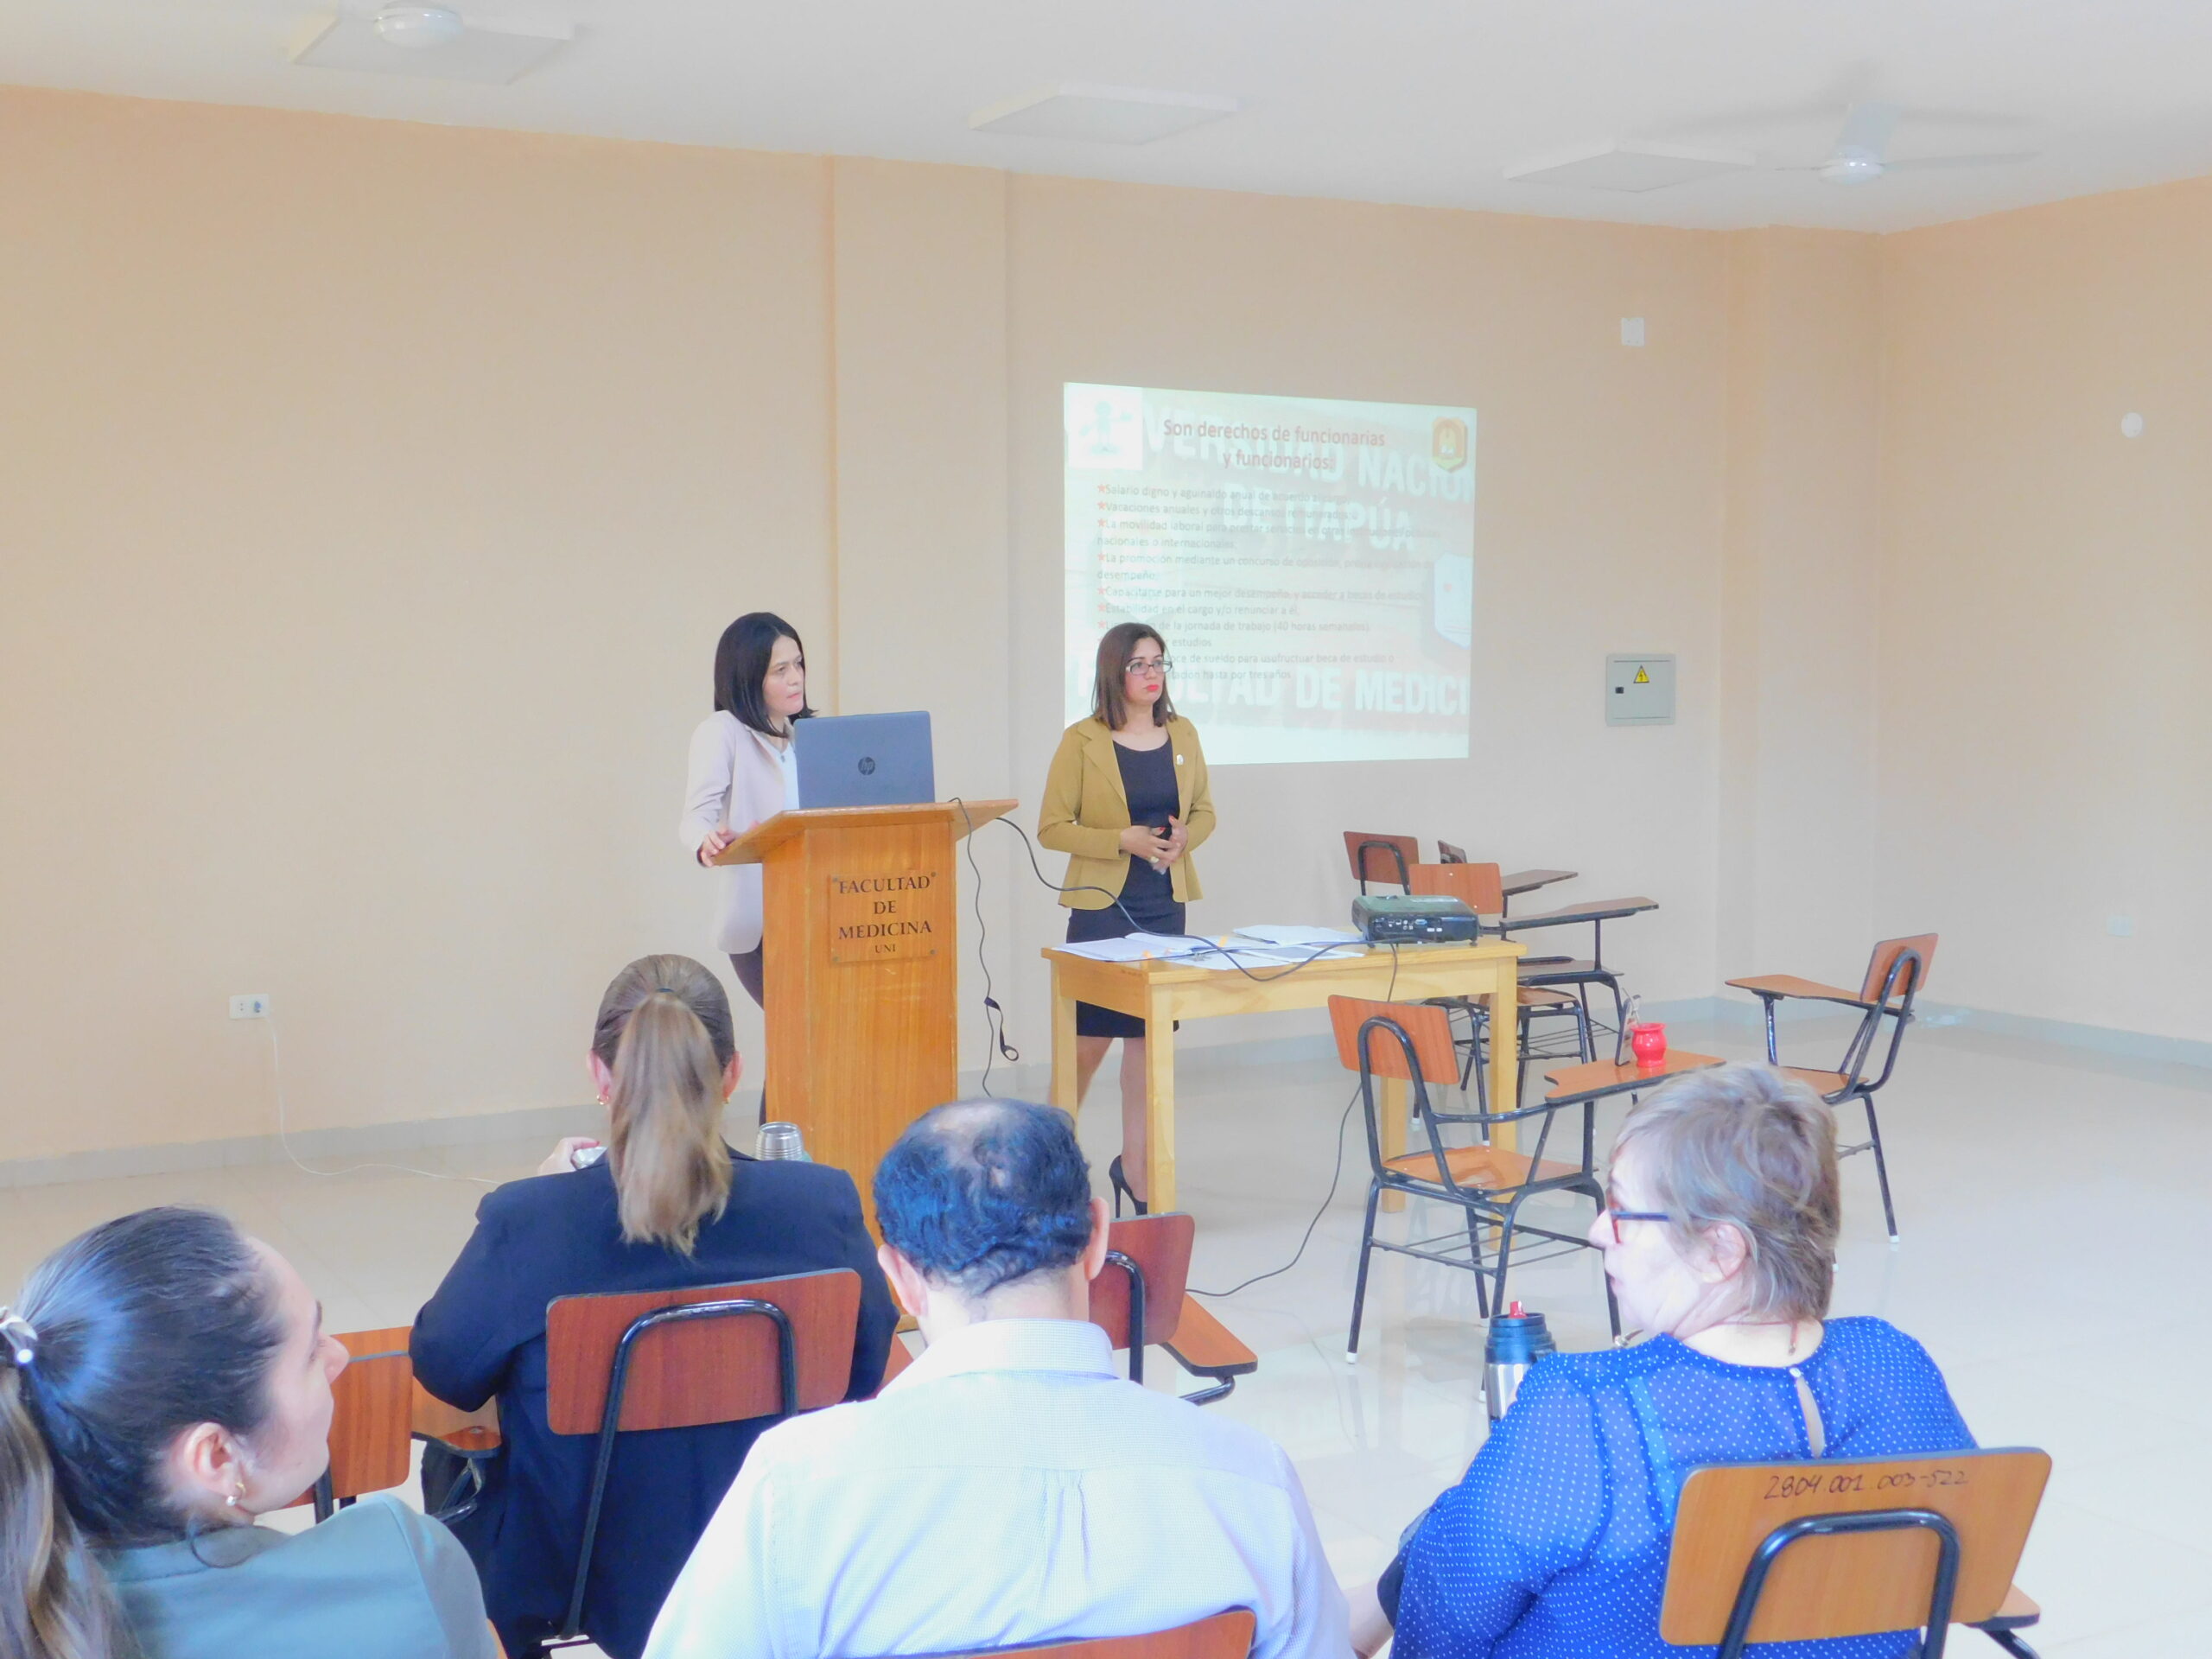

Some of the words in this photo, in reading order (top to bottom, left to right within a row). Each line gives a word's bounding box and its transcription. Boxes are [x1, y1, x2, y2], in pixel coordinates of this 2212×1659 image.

[1164, 418, 1192, 437] Son
[1198, 421, 1268, 442] derechos
[1272, 423, 1291, 442] de
[1294, 424, 1386, 447] funcionarias
[1223, 453, 1230, 468] y
[1105, 484, 1140, 496] Salario
[1142, 485, 1170, 499] digno
[1173, 489, 1178, 499] y
[1180, 486, 1227, 500] aguinaldo
[1230, 490, 1255, 500] anual
[1258, 490, 1271, 501] de
[1105, 501, 1160, 514] Vacaciones
[1163, 503, 1200, 516] anuales
[1203, 506, 1208, 517] y
[1211, 505, 1236, 517] otros
[1237, 506, 1285, 518] descansos
[1106, 519, 1116, 530] La
[1120, 519, 1167, 531] movilidad
[1170, 520, 1204, 532] laboral
[1206, 523, 1227, 535] para
[1096, 535, 1149, 547] nacionales
[1153, 537, 1159, 547] o
[1106, 552, 1116, 563] La
[1120, 552, 1172, 565] promoción
[1175, 554, 1220, 566] mediante
[1223, 556, 1236, 566] un
[1237, 556, 1280, 567] concurso
[1282, 556, 1294, 567] de
[1165, 588, 1185, 601] para
[1189, 588, 1202, 599] un
[1205, 588, 1232, 601] mejor
[1105, 603, 1159, 615] Estabilidad
[1161, 606, 1174, 615] en
[1176, 604, 1185, 615] el
[1187, 607, 1214, 618] cargo
[1216, 605, 1232, 617] y/o
[1234, 606, 1279, 616] renunciar
[1159, 620, 1171, 631] de
[1173, 620, 1183, 631] la
[1185, 620, 1221, 633] jornada
[1224, 620, 1235, 632] de
[1237, 620, 1271, 633] trabajo
[1273, 620, 1287, 633] (40
[1291, 620, 1317, 632] horas
[1172, 638, 1212, 648] estudios
[1189, 653, 1201, 664] de
[1204, 653, 1236, 664] sueldo
[1238, 655, 1259, 666] para
[1261, 653, 1314, 664] usufructuar
[1316, 653, 1338, 664] beca
[1340, 653, 1351, 664] de
[1353, 654, 1386, 664] estudio
[1388, 656, 1395, 664] o
[1202, 670, 1228, 682] hasta
[1230, 671, 1246, 683] por
[1249, 670, 1268, 681] tres
[1269, 669, 1292, 681] años
[1296, 663, 1343, 712] DE
[838, 875, 931, 894] FACULTAD
[874, 900, 897, 915] DE
[838, 920, 932, 940] MEDICINA
[874, 943, 897, 954] UNI
